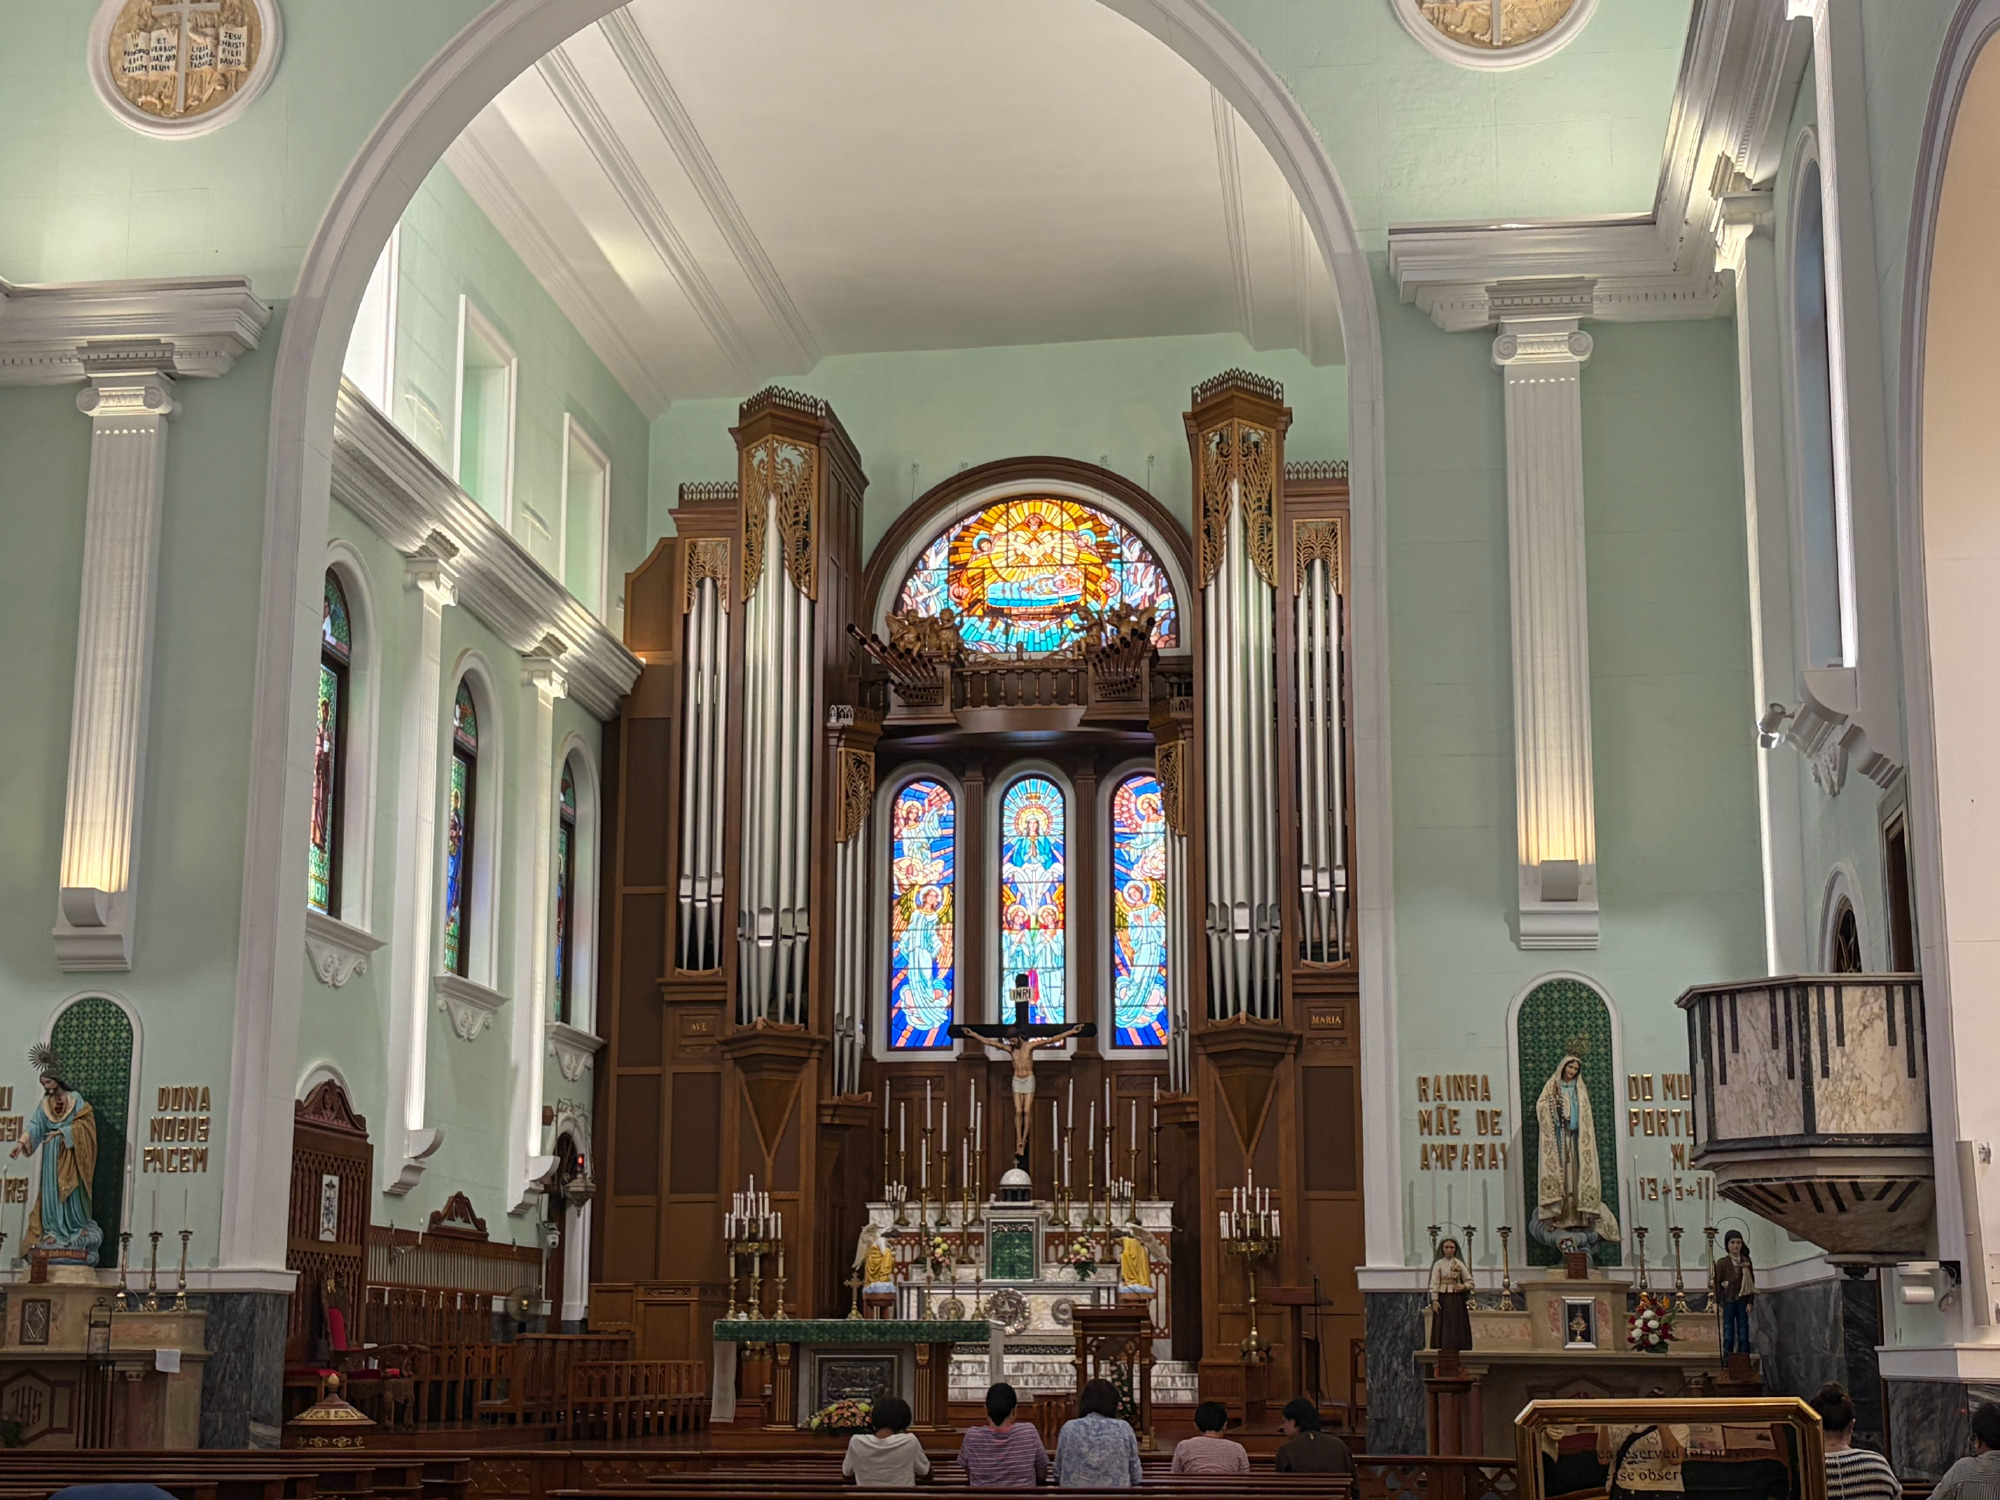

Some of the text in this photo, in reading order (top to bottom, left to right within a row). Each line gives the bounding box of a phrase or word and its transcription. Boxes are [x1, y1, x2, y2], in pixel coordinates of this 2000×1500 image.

[224, 31, 241, 40] JESU
[1012, 988, 1031, 1001] INRI
[691, 1022, 707, 1031] AVE
[1312, 1015, 1341, 1024] MARIA
[158, 1086, 211, 1112] DONA
[1418, 1074, 1491, 1102] RAINHA
[1628, 1073, 1690, 1101] DO MU
[150, 1116, 210, 1142] NOBIS
[1418, 1104, 1502, 1136] MÃE DE
[143, 1147, 209, 1173] PACEM
[1623, 1447, 1680, 1459] eserved
